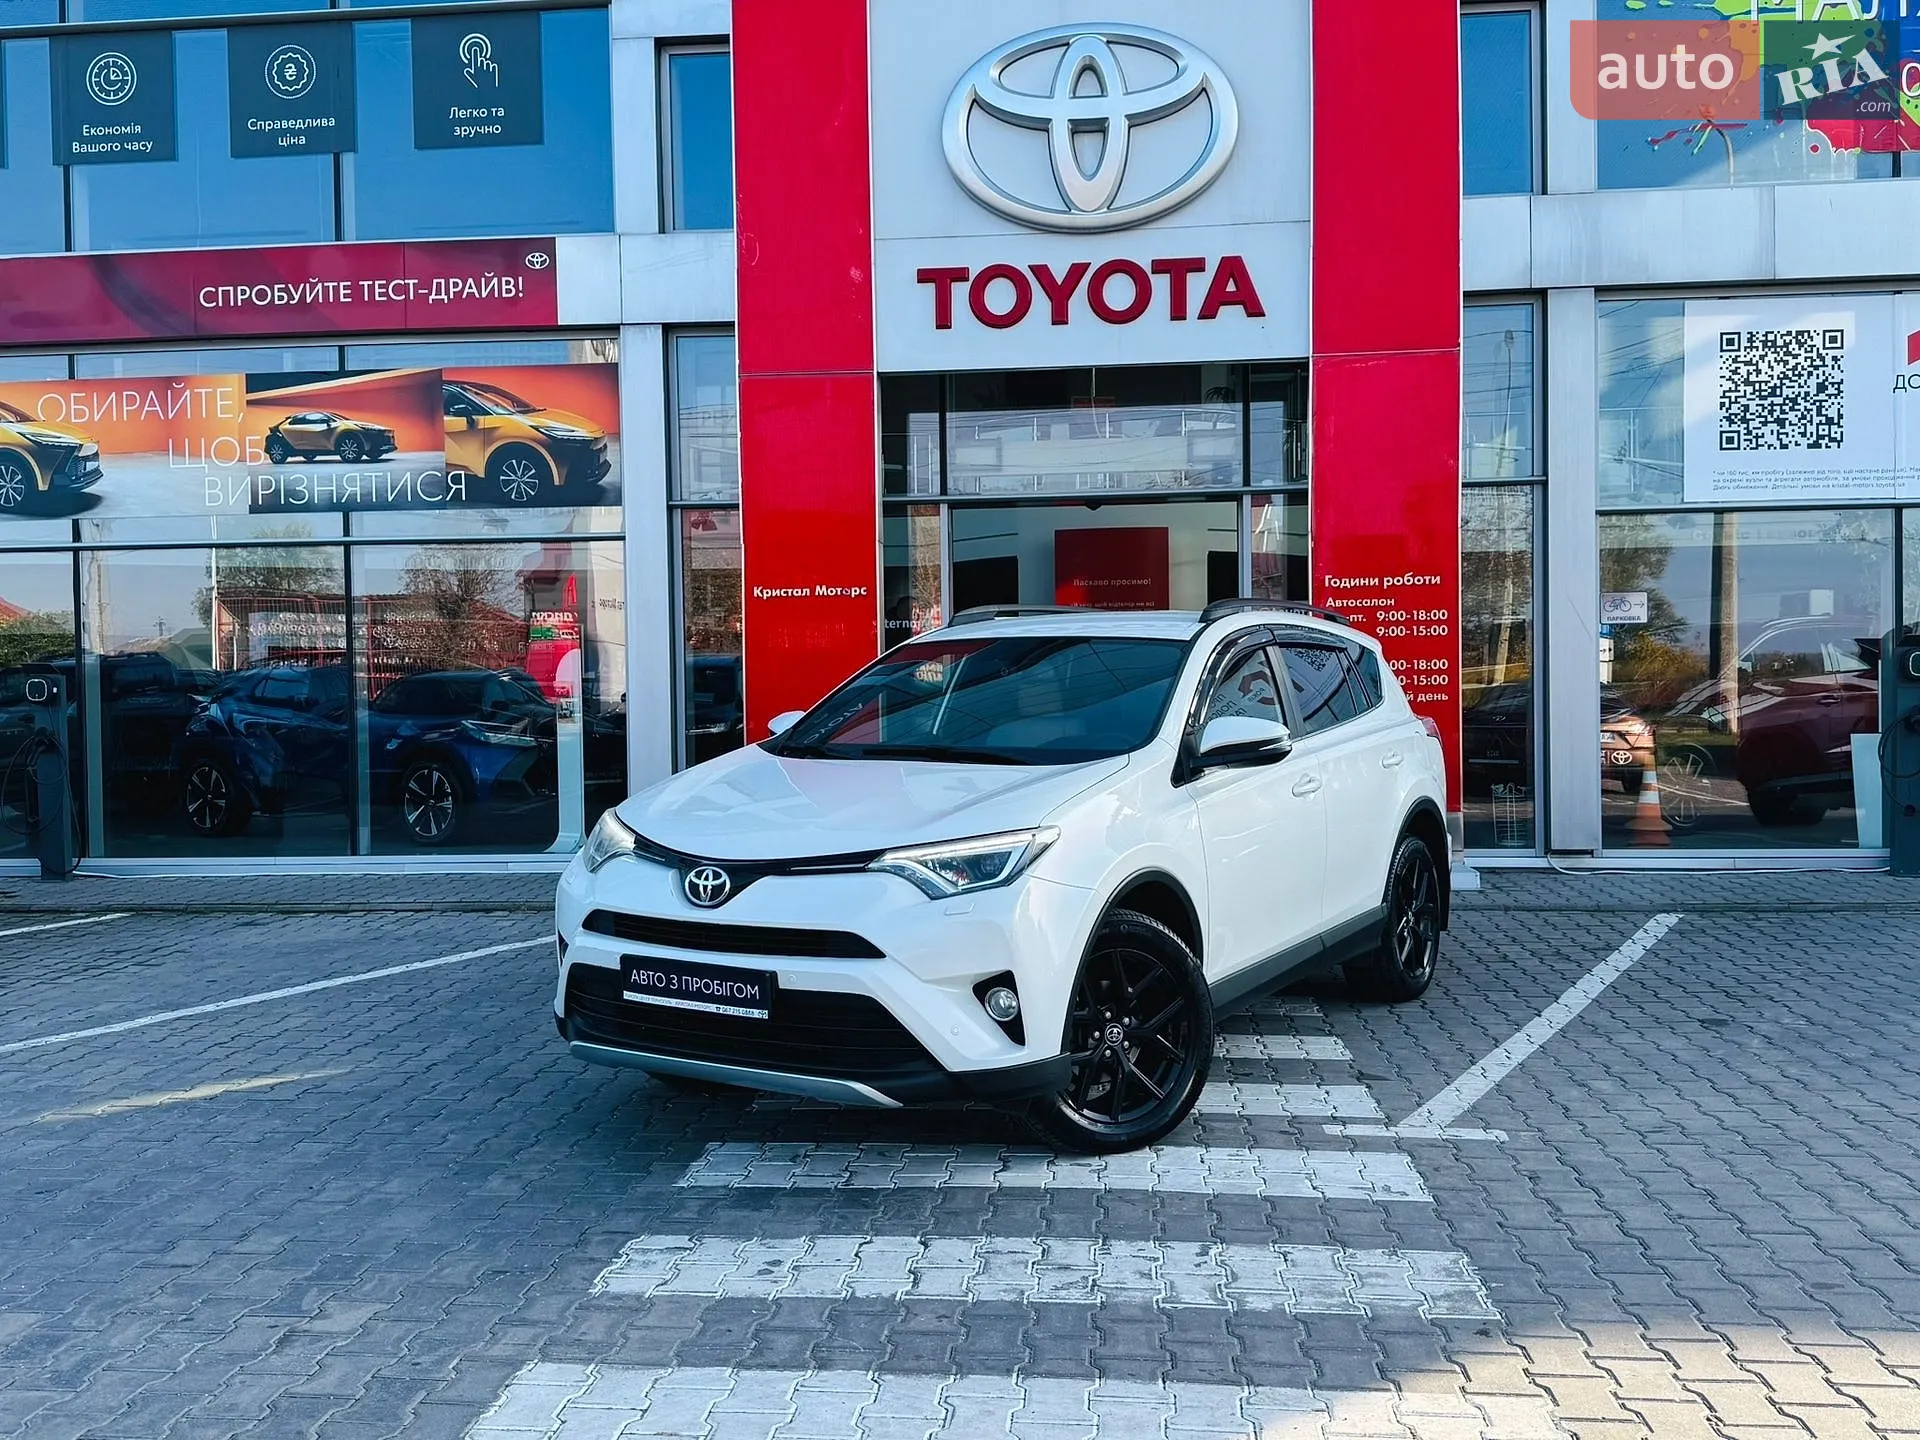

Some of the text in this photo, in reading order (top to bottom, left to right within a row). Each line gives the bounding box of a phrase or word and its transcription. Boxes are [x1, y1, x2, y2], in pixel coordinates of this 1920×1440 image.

[449, 105, 506, 119] Легко та
[82, 122, 142, 137] Економія
[247, 116, 336, 132] Справедлива
[453, 122, 502, 137] зручно
[72, 138, 153, 153] Вашого часу
[278, 132, 306, 147] ціна
[199, 271, 525, 308] СПРОБУЙТЕ ТЕСТ-ДРАЙВ!
[916, 255, 1266, 330] TOYOTA
[37, 383, 245, 423] ОБИРАЙТЕ,
[168, 435, 265, 471] ЩОБ
[205, 470, 467, 508] ВИРІЗНЯТИСЯ
[1325, 572, 1441, 589] Години роботи
[753, 583, 868, 599] Кристал Моторс
[1325, 597, 1395, 608] Автосалон
[1376, 609, 1448, 622] 9:00-18:00
[1376, 625, 1448, 637] 9:00-15:00
[1417, 692, 1449, 702] день
[631, 969, 760, 1000] АВТО З ПРОБІГОМ
